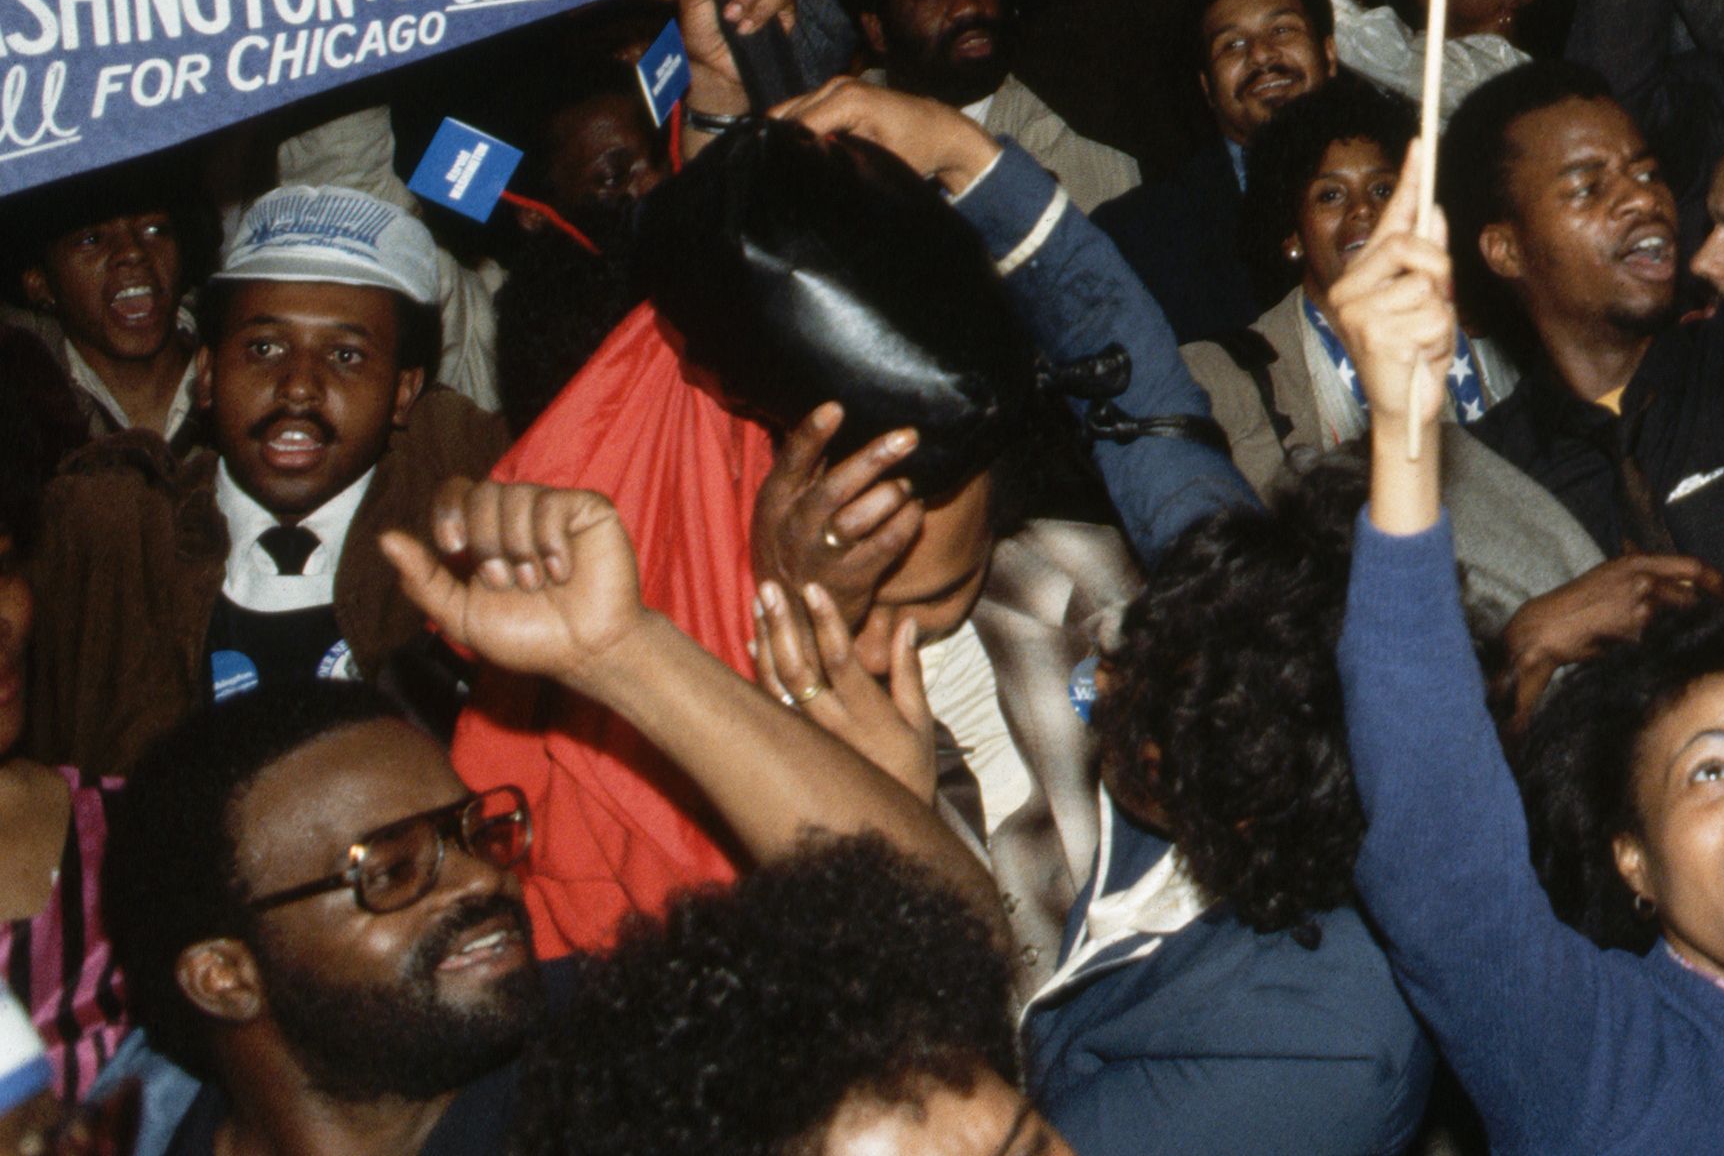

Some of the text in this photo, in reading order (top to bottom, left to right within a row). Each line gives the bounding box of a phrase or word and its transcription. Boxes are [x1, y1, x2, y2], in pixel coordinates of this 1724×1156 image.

[0, 11, 447, 148] ll FOR CHICAGO
